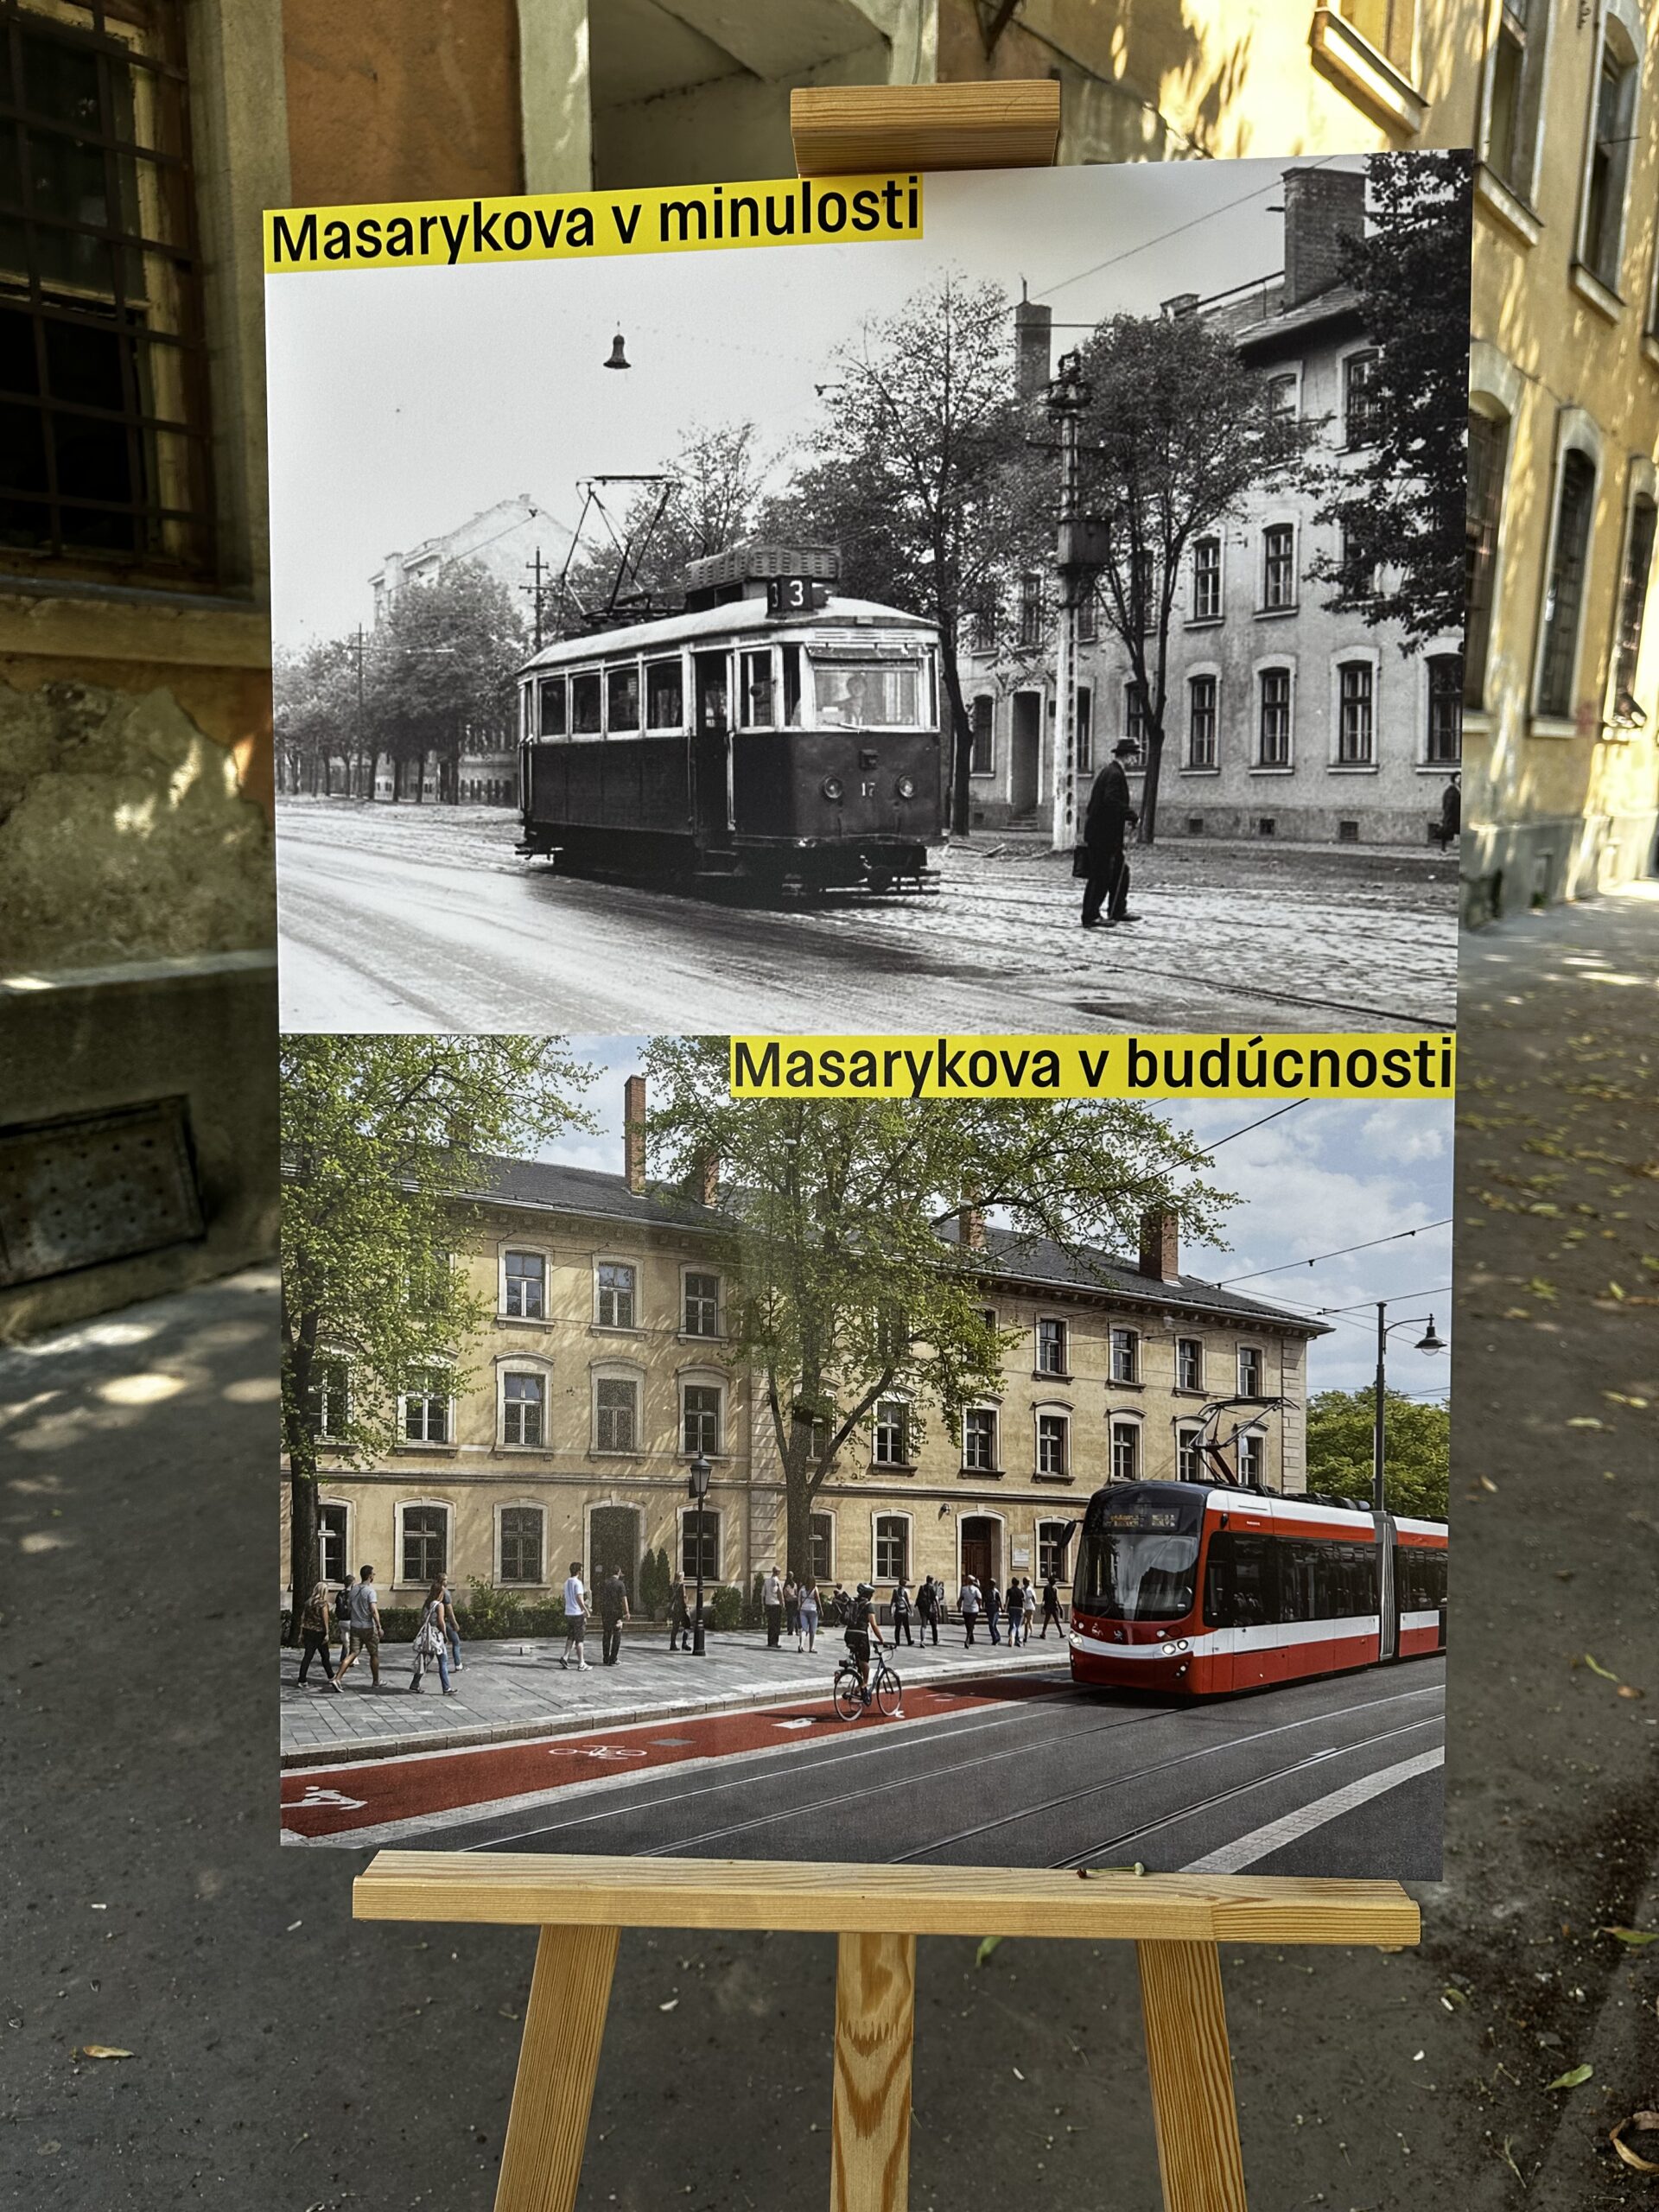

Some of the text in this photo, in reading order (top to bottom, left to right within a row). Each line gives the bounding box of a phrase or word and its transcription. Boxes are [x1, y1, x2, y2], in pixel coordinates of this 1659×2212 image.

[273, 175, 918, 264] Masarykova v minulosti
[789, 580, 804, 607] 3
[735, 1035, 1452, 1097] Masarykova v budúcnosti
